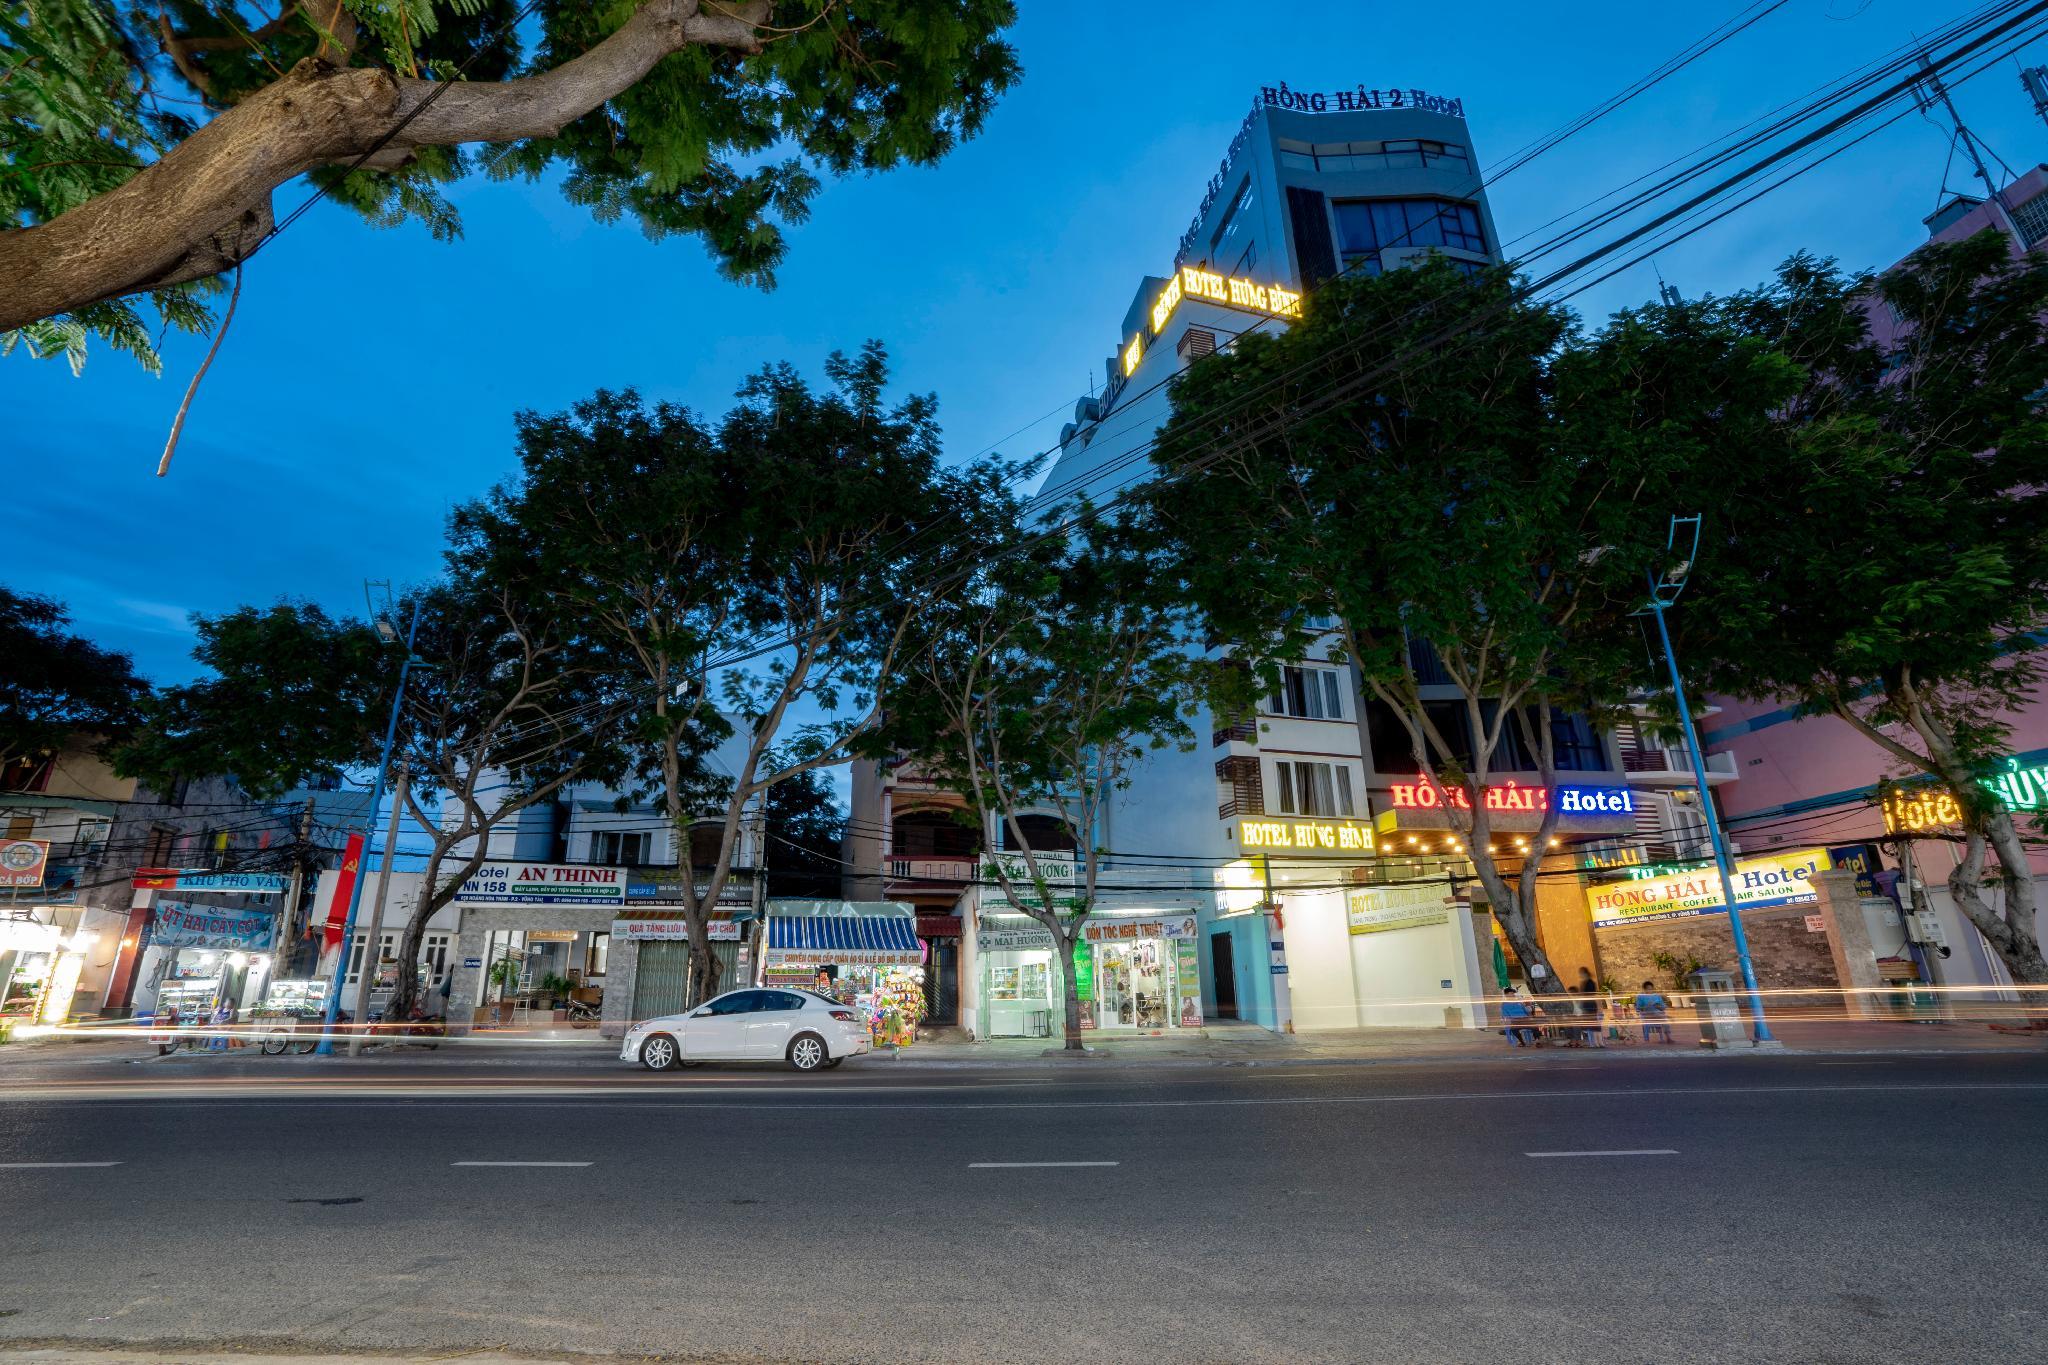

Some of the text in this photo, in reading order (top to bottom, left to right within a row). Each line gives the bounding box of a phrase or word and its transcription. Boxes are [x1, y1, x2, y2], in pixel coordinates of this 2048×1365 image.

[1261, 80, 1466, 118] HỒNG HẢI 2 Hotel
[1182, 267, 1228, 300] HOTEL
[1229, 278, 1268, 310] HƯNG
[1561, 789, 1633, 812] Hotel
[1241, 820, 1374, 849] HOTEL HƯNG BÌNH
[15, 874, 38, 884] BỚP
[517, 867, 548, 881] AN
[553, 867, 617, 886] THỊNH
[1037, 862, 1069, 878] ƯƠNG
[463, 881, 507, 893] NN 158
[1595, 884, 1657, 909] HỒNG
[1666, 875, 1709, 900] HẢI
[1741, 862, 1817, 888] Hotel
[1619, 900, 1674, 915] RESTAURANT
[1683, 896, 1719, 907] COFFEE
[182, 910, 207, 932] HAI
[629, 922, 644, 934] QUÀ
[1103, 922, 1117, 939] TÓC
[994, 936, 1014, 947] MAI
[1016, 934, 1051, 945] HƯƠNG
